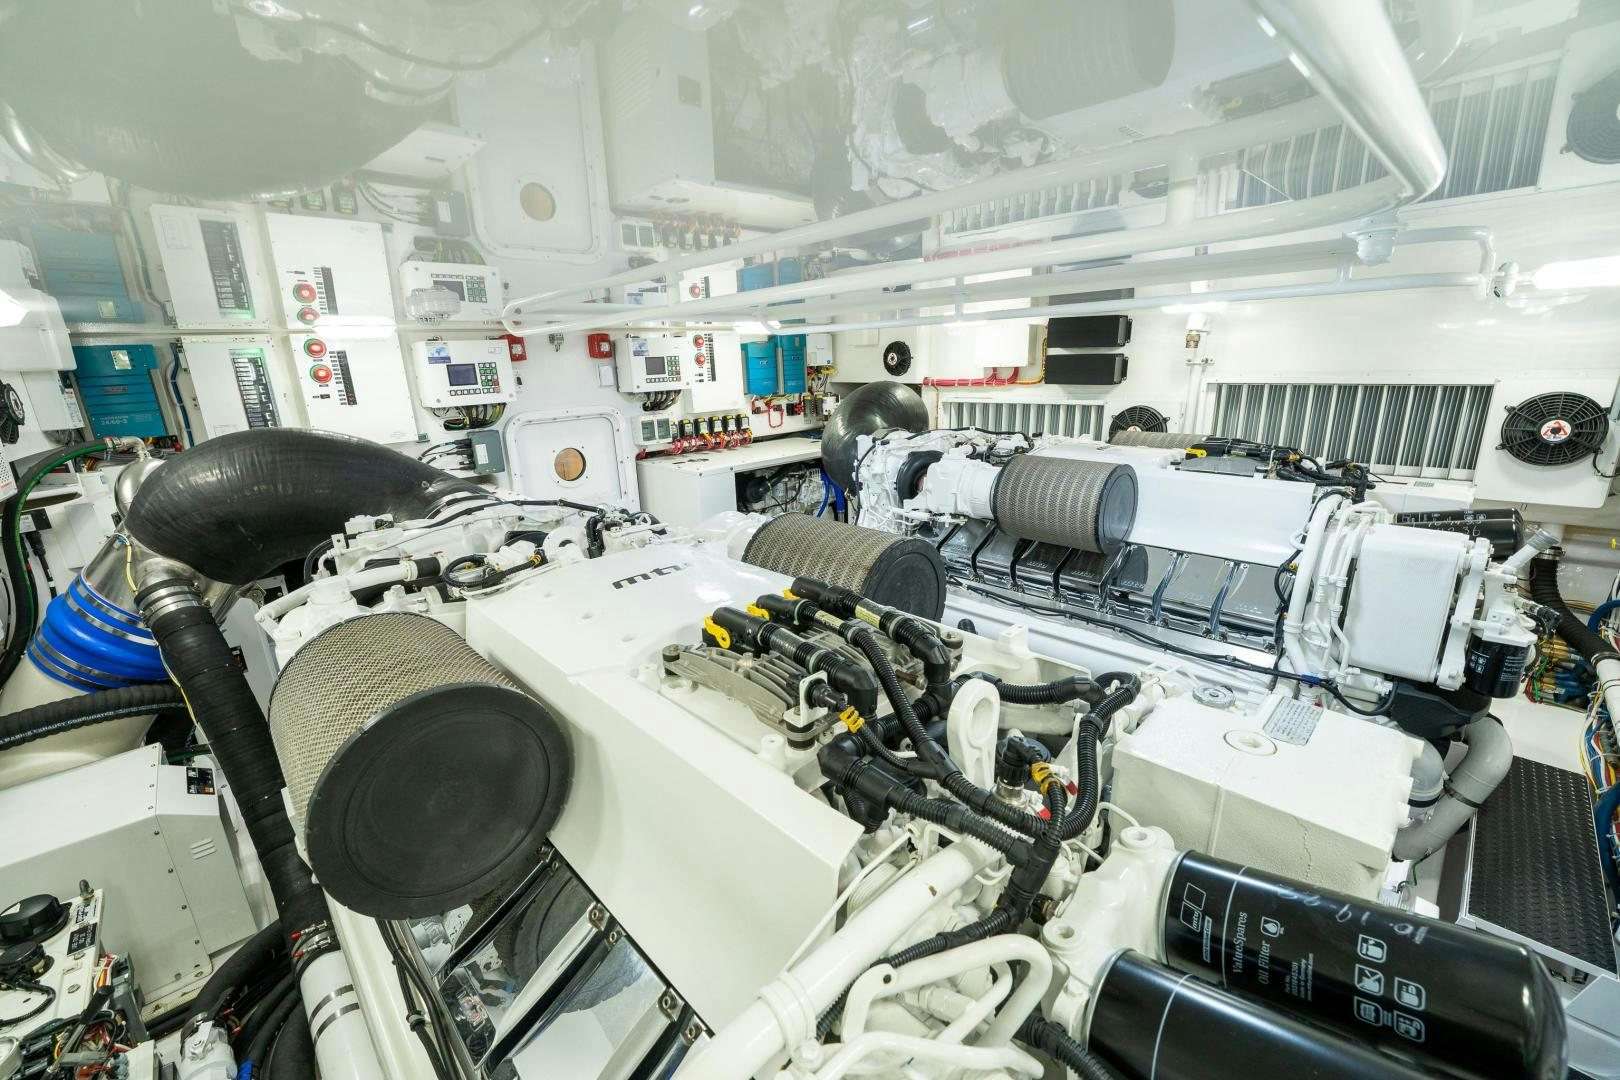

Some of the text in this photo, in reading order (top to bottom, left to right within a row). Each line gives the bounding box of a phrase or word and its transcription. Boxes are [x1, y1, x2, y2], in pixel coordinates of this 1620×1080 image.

[1232, 911, 1249, 974] ValueSpares
[1257, 940, 1272, 985] Oil Filter
